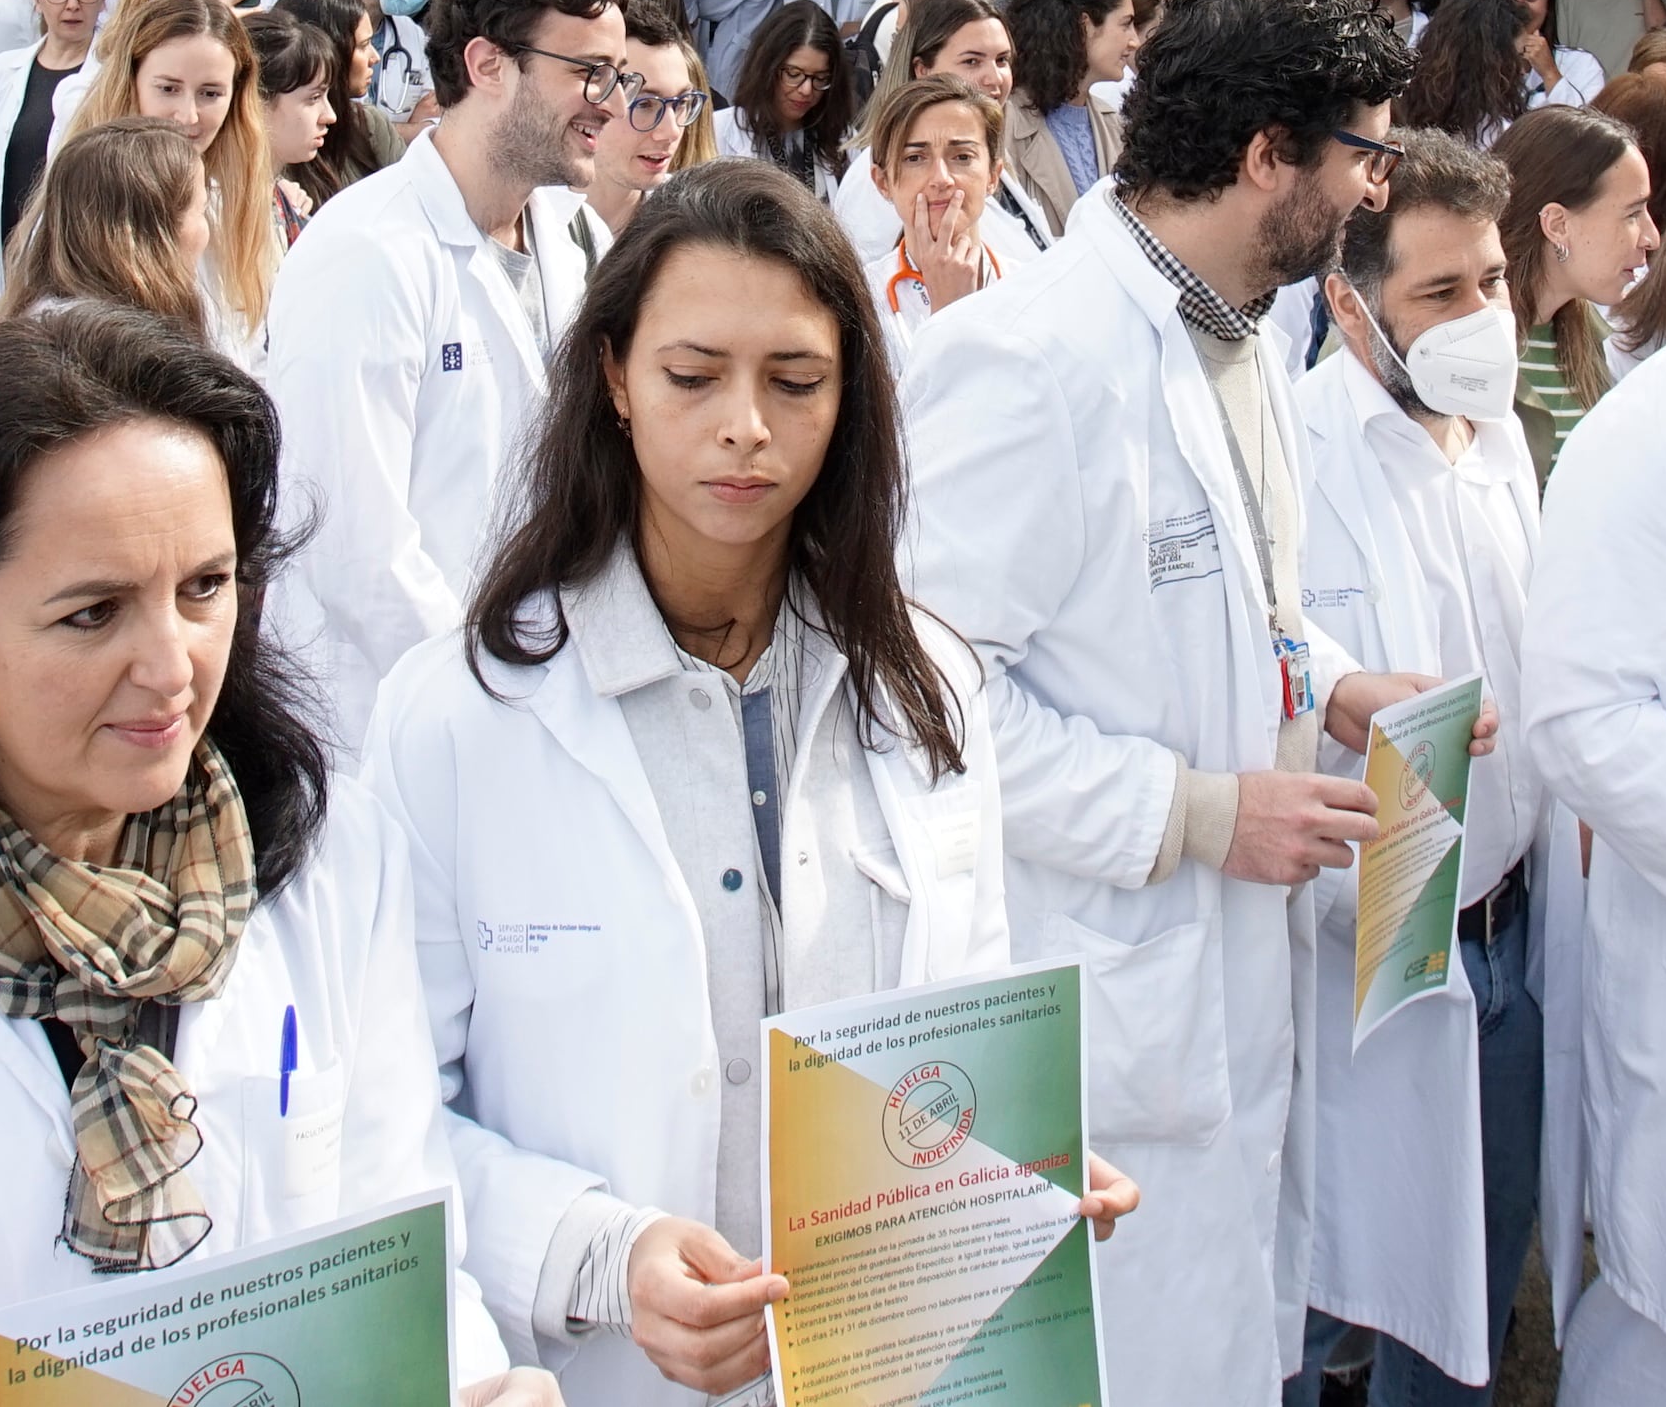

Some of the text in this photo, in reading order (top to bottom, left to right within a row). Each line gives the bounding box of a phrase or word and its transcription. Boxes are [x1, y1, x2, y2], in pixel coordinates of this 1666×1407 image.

[789, 1002, 1062, 1072] la dignidad de los profesionales sanitarios
[794, 983, 1057, 1049] Por la seguridad de nuestros pacientes y
[889, 1065, 940, 1109] HUELGA
[898, 1093, 959, 1140] 11 DE ABRIL
[912, 1107, 974, 1165] INDEFINIDA
[788, 1152, 1070, 1233] La Sanidad Pública en Galicia agoniza
[815, 1181, 1054, 1247] EXIGIMOS PARA ATENCIÓN HOSPITALARIA
[820, 1272, 832, 1281] del
[833, 1266, 856, 1281] precio
[858, 1263, 867, 1272] de
[869, 1255, 901, 1270] guardias
[953, 1234, 986, 1248] laborales
[1058, 1216, 1068, 1225] los
[850, 1276, 862, 1286] del
[963, 1250, 982, 1261] igual
[1012, 1238, 1030, 1250] igual
[1031, 1233, 1055, 1245] salario
[878, 1245, 888, 1253] de
[889, 1242, 896, 1250] la
[927, 1231, 936, 1240] de
[949, 1226, 969, 1236] horas
[971, 1216, 1010, 1231] semanales
[16, 1230, 412, 1354] Por la seguridad de nuestros pacientes y
[828, 1310, 842, 1321] tras
[873, 1300, 882, 1309] de
[884, 1295, 908, 1306] festivo
[846, 1291, 856, 1300] de
[857, 1287, 869, 1296] los
[888, 1281, 897, 1290] de
[898, 1277, 915, 1288] libre
[958, 1265, 968, 1275] de
[8, 1253, 419, 1386] la dignidad de los profesionales sanitarios
[796, 1336, 810, 1347] Los
[829, 1328, 838, 1337] 24
[858, 1319, 867, 1328] de
[868, 1311, 905, 1327] diciembre
[906, 1306, 927, 1316] como
[928, 1302, 938, 1311] no
[939, 1293, 972, 1308] laborales
[974, 1288, 990, 1300] para
[841, 1353, 851, 1362] de
[852, 1349, 864, 1359] las
[865, 1342, 896, 1358] guardias
[946, 1324, 956, 1334] de
[957, 1320, 970, 1330] sus
[850, 1365, 859, 1375] de
[860, 1362, 872, 1372] los
[904, 1350, 914, 1360] de
[901, 1366, 913, 1376] del
[914, 1360, 932, 1371] Tutor
[934, 1355, 943, 1365] de
[953, 1379, 962, 1389] de
